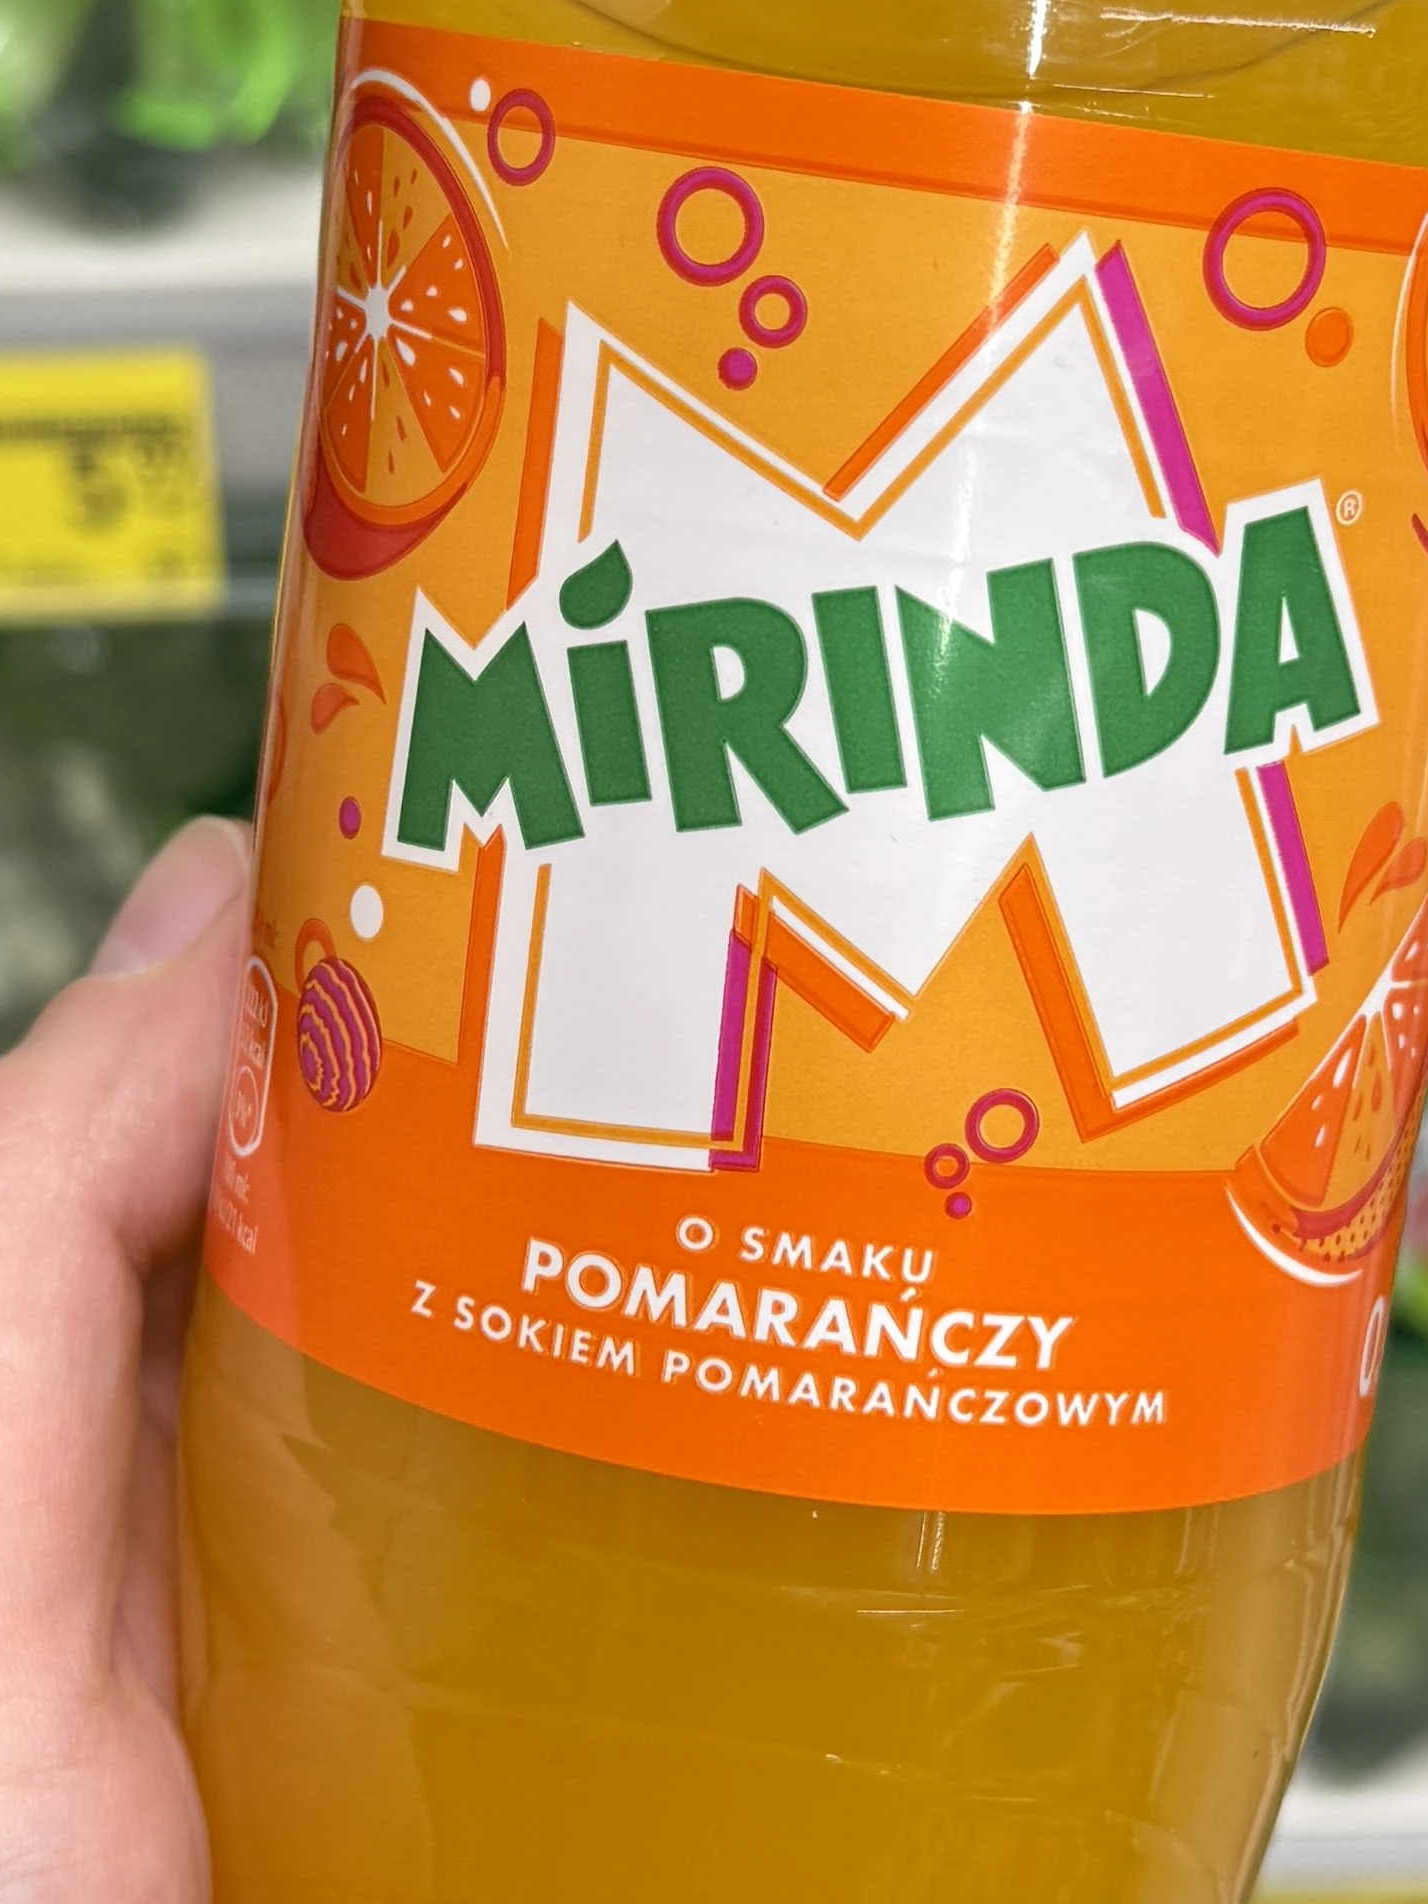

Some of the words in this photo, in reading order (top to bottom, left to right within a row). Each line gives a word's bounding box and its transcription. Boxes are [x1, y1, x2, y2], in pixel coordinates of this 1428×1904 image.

[522, 1238, 1074, 1370] POMARAŃCZY
[677, 1216, 714, 1252] O
[739, 1226, 934, 1284] SMAKU
[411, 1278, 436, 1317] Z
[453, 1295, 635, 1375] SOKIEM
[663, 1350, 1165, 1427] POMARAŃCZOWYM
